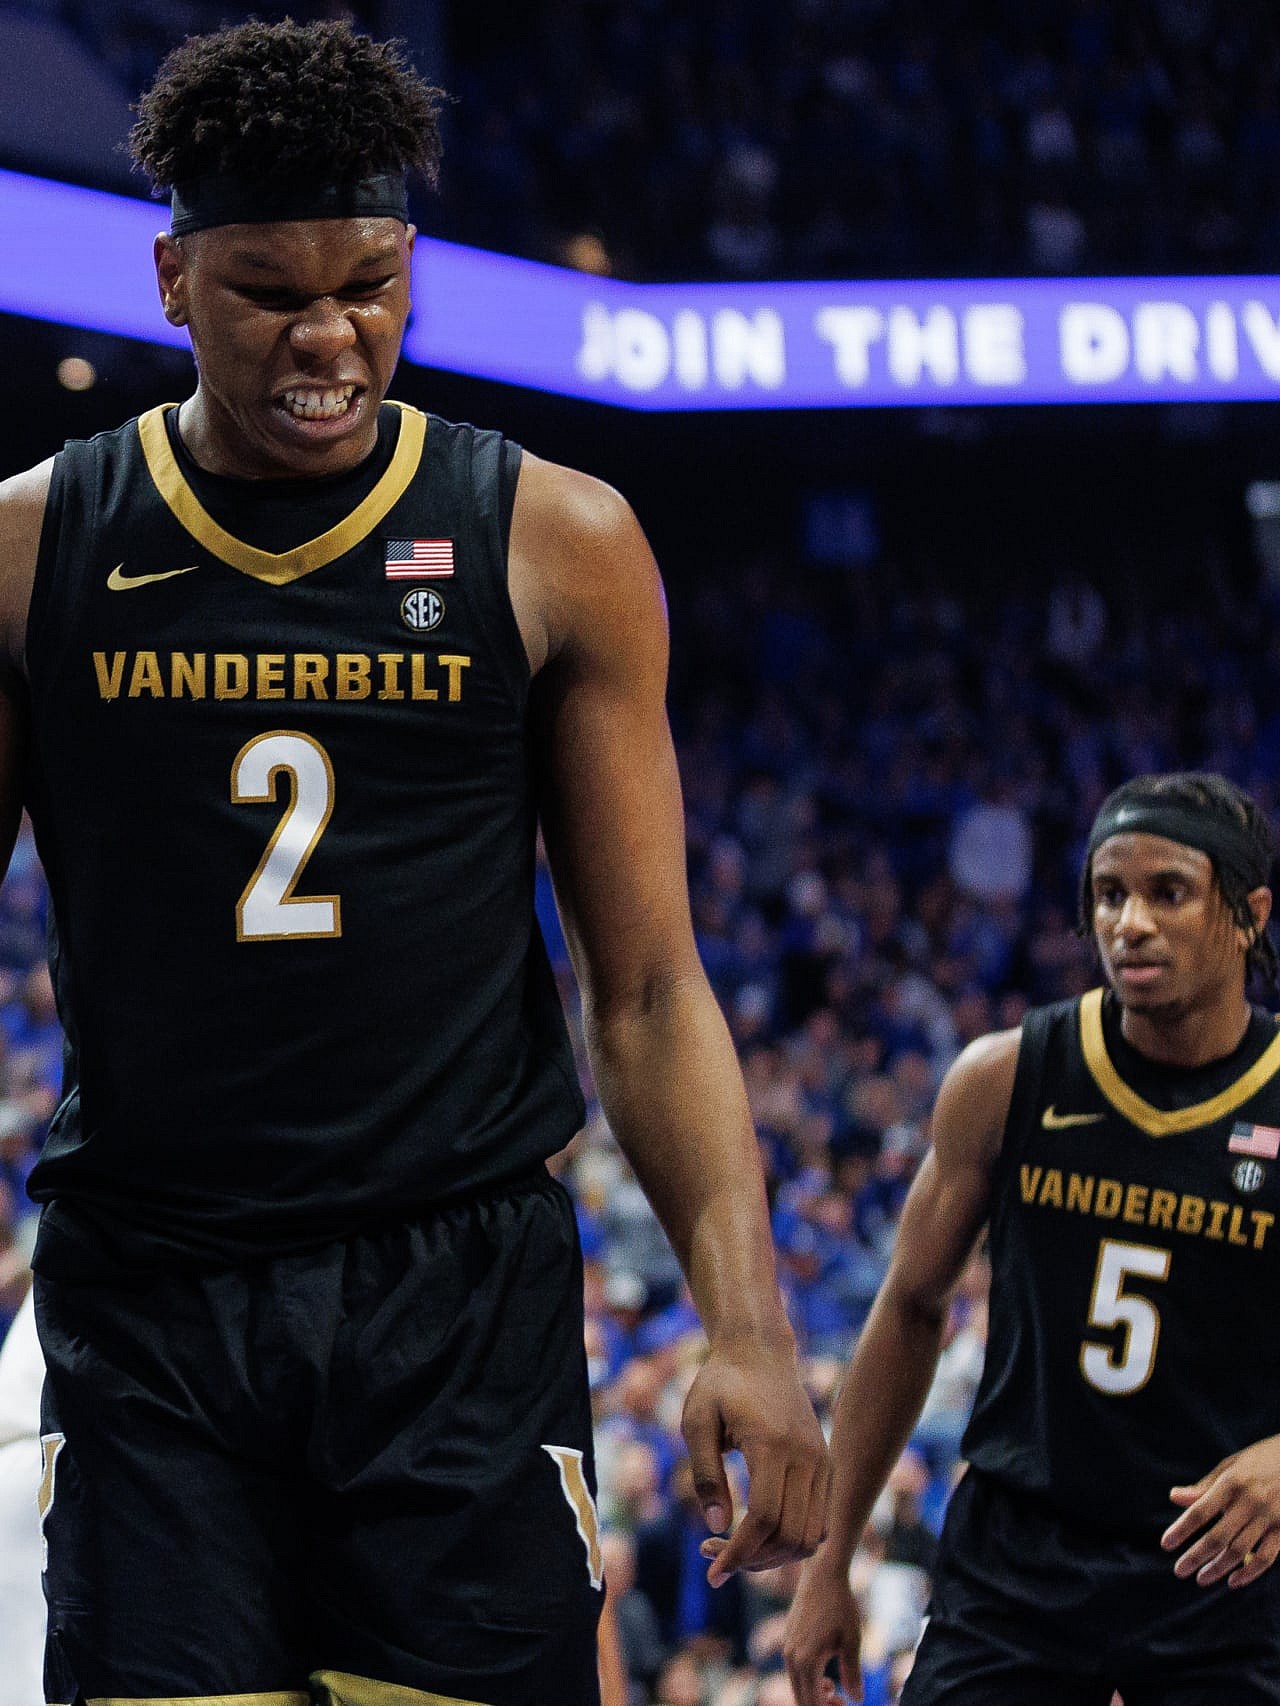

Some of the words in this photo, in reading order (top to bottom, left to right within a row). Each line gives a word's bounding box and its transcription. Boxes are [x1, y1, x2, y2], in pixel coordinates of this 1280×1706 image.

[577, 300, 786, 391] JOIN
[816, 301, 1025, 388] THE
[404, 591, 441, 628] SEC
[93, 651, 471, 702] VANDERBILT
[230, 730, 342, 942] 2
[1020, 1164, 1275, 1250] VANDERBILT
[1078, 1237, 1172, 1397] 5
